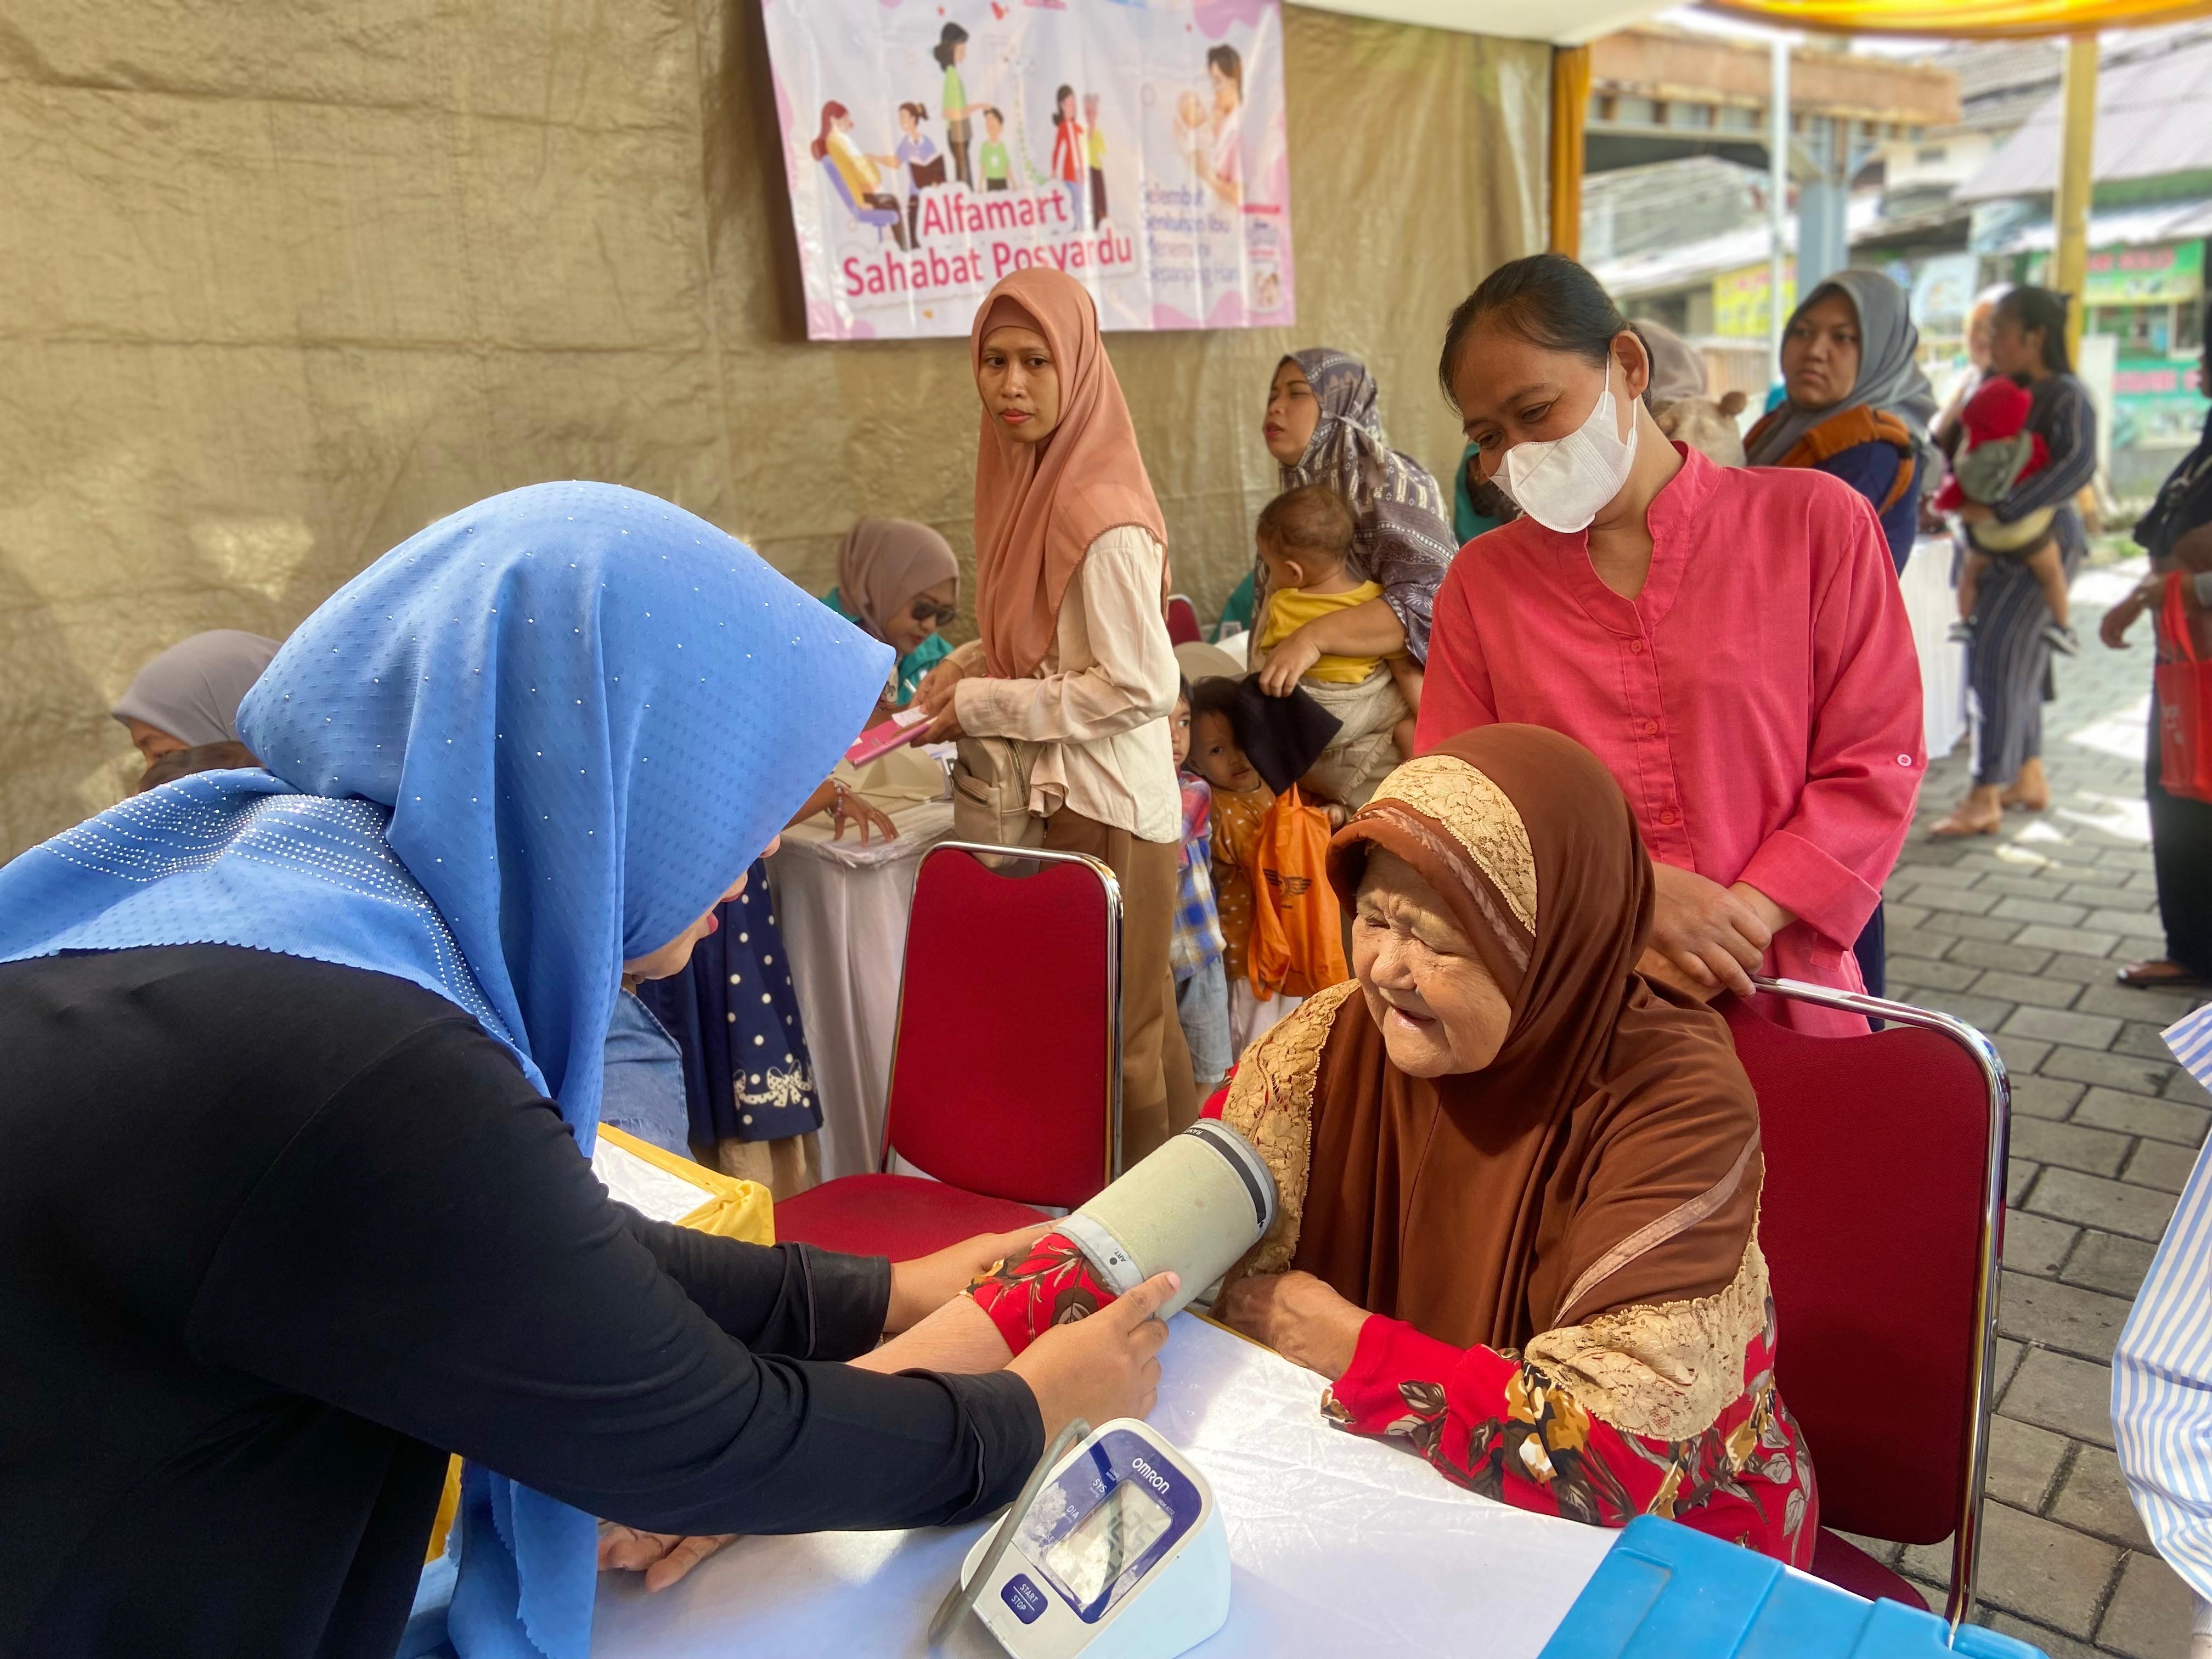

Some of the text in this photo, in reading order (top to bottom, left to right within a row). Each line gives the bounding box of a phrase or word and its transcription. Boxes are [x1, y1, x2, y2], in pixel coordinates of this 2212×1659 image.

[923, 188, 1067, 236] Alfamart
[843, 246, 984, 297] Sahabat
[1092, 1479, 1107, 1493] SYS
[1132, 1458, 1170, 1494] OMRON
[1066, 1505, 1080, 1519] DIA
[1011, 1595, 1026, 1610] STOP
[1020, 1583, 1039, 1603] START
